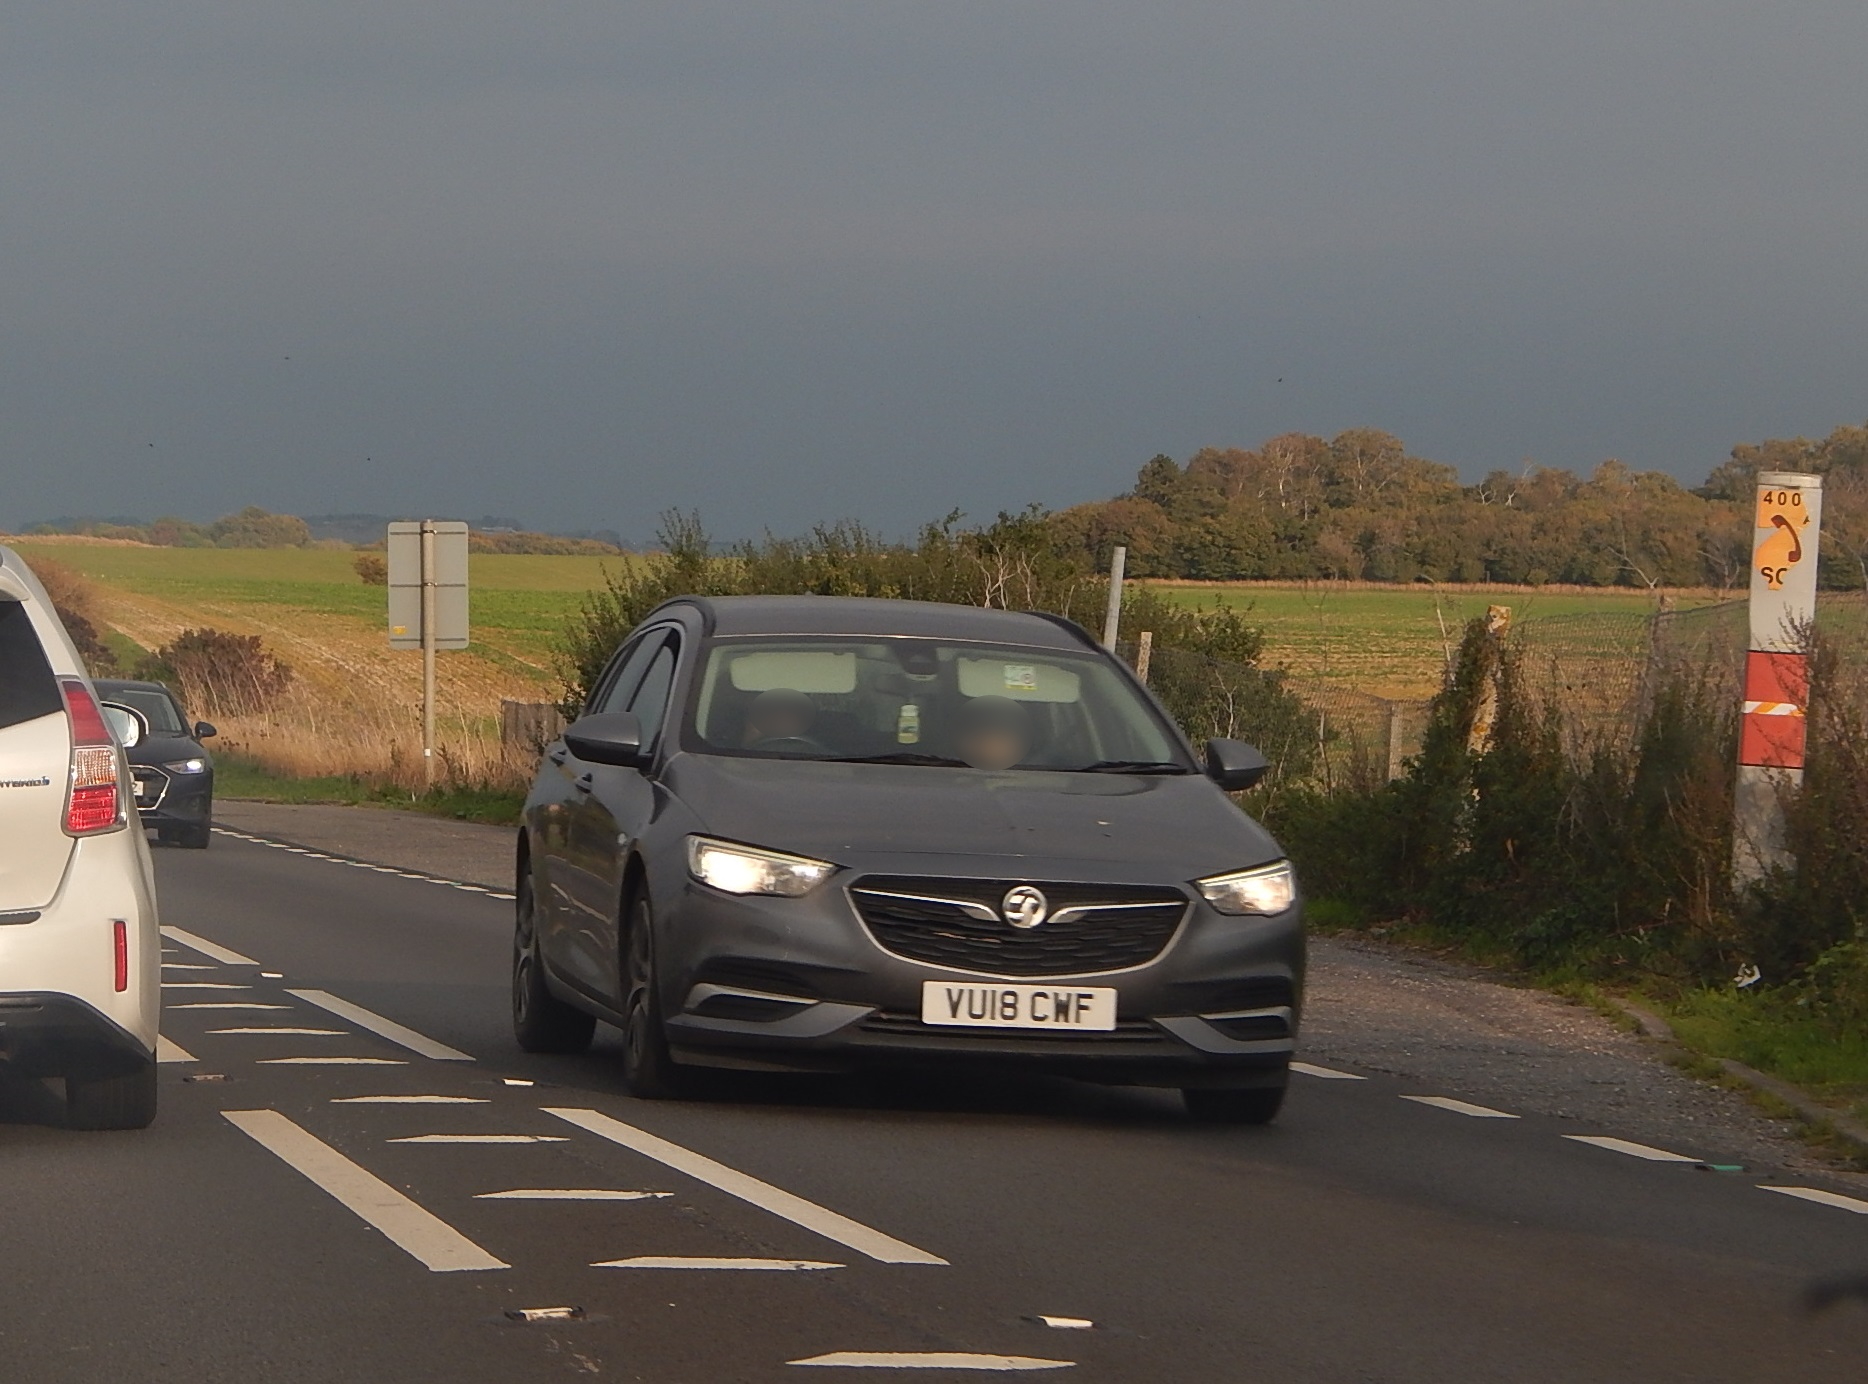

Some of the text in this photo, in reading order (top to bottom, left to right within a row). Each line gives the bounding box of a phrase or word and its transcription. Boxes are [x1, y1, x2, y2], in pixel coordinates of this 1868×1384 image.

[1763, 491, 1801, 506] 400
[946, 988, 1094, 1023] VU18 CWF
